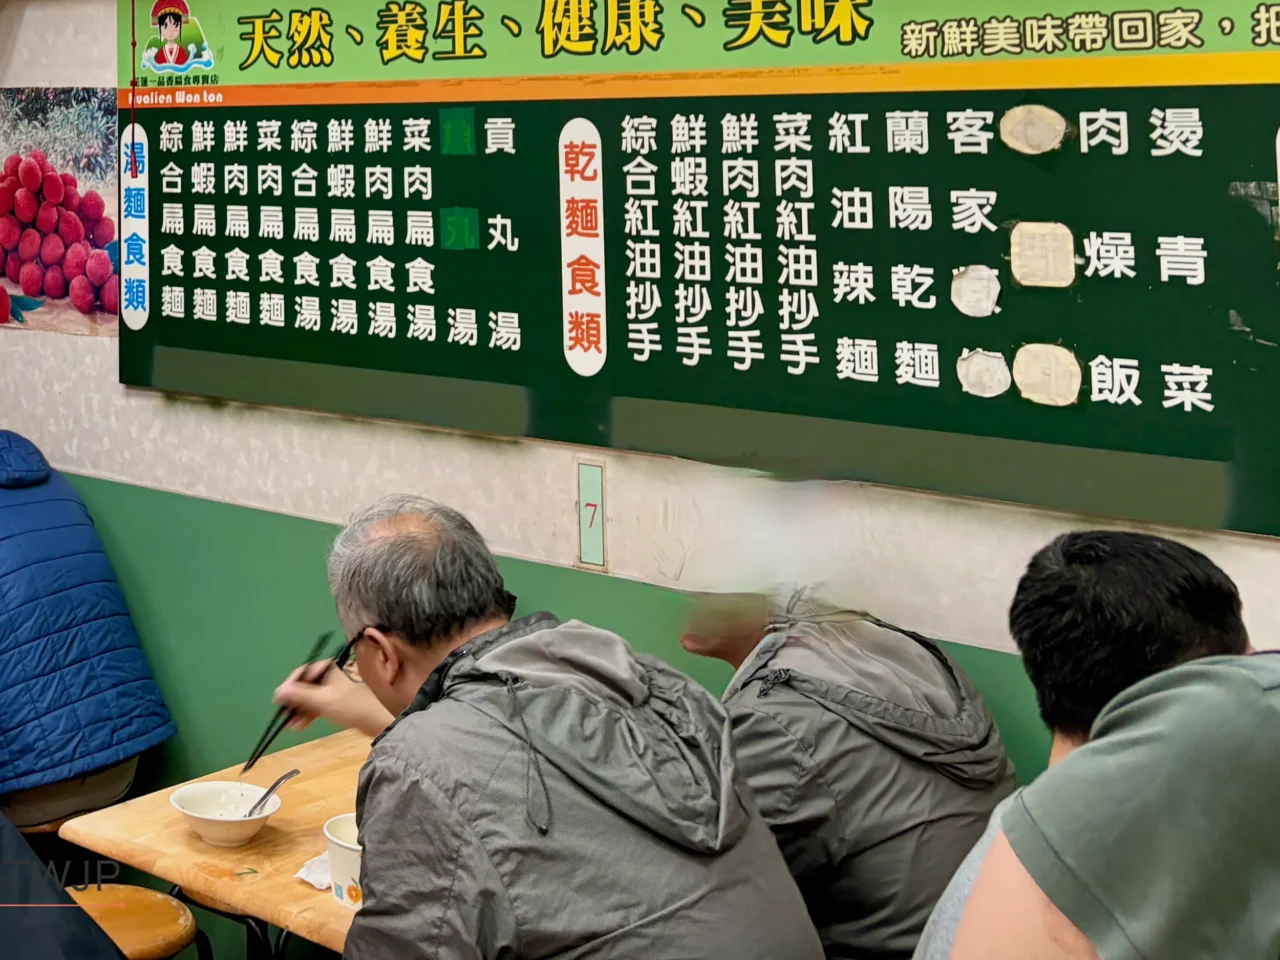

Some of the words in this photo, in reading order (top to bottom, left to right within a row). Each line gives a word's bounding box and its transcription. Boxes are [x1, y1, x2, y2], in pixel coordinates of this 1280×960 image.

[175, 91, 200, 104] Won
[203, 90, 223, 103] ton
[160, 121, 185, 319] 綜合扁食麵
[191, 121, 217, 321] 鮮蝦扁食麵
[224, 120, 250, 325] 鮮肉扁食麵
[256, 120, 285, 327] 菜肉扁食麵
[291, 120, 321, 331] 綜合扁食湯
[327, 119, 358, 335] 鮮蝦扁食湯
[364, 119, 397, 339] 鮮肉扁食湯
[402, 118, 437, 342] 菜肉扁食湯
[484, 118, 521, 351] 貢丸湯
[564, 141, 602, 354] 乾麵食類
[621, 115, 663, 362] 綜合紅油抄手
[670, 113, 713, 366] 鮮蝦紅油抄手
[720, 113, 765, 371] 鮮肉紅油抄手
[773, 113, 820, 375] 菜肉紅油抄手
[828, 112, 880, 383] 紅油辣麵
[885, 110, 941, 388] 蘭陽乾麵
[584, 502, 598, 528] 7
